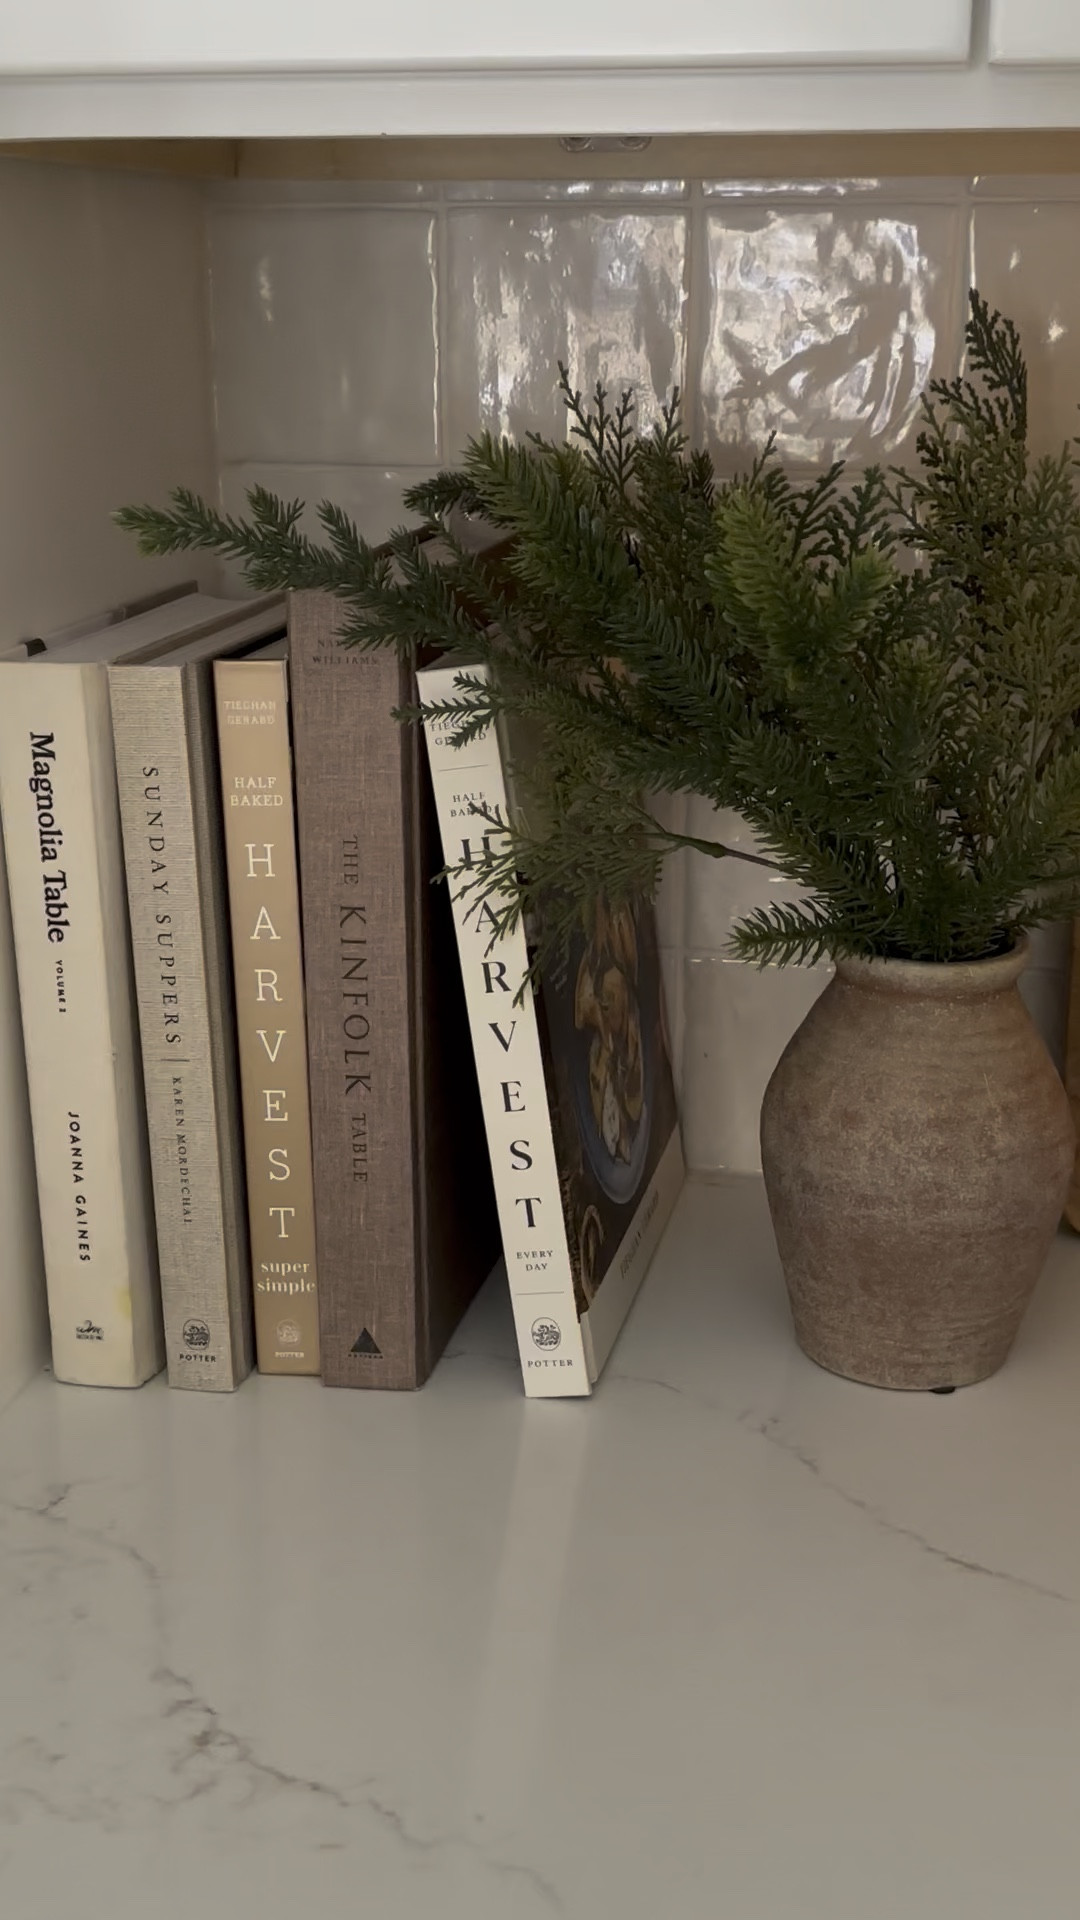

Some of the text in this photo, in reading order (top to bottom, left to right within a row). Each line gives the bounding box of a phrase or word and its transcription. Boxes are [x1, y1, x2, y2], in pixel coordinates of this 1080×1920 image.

[312, 655, 378, 665] WILLIAMS
[435, 732, 486, 746] GED
[234, 776, 277, 790] HALF
[230, 794, 284, 807] BAKED
[452, 792, 486, 803] HALF
[450, 805, 492, 818] BAD
[30, 731, 71, 944] Magnolia Table
[142, 766, 181, 1044] SUNDAY SUPPERS
[55, 959, 66, 1003] VOLUME
[339, 834, 372, 1183] THE KINFOLK TABLE
[460, 836, 541, 1228] HARVEST
[244, 842, 296, 1239] HARVEST
[172, 1076, 192, 1223] KAREN MORDECHAI
[67, 1111, 91, 1262] JOANNA GAINES
[516, 1249, 554, 1260] EVERY
[260, 1262, 311, 1276] super
[525, 1262, 548, 1272] DAY
[256, 1277, 316, 1296] simple
[179, 1353, 217, 1363] POTTER
[527, 1358, 573, 1368] POTTER
